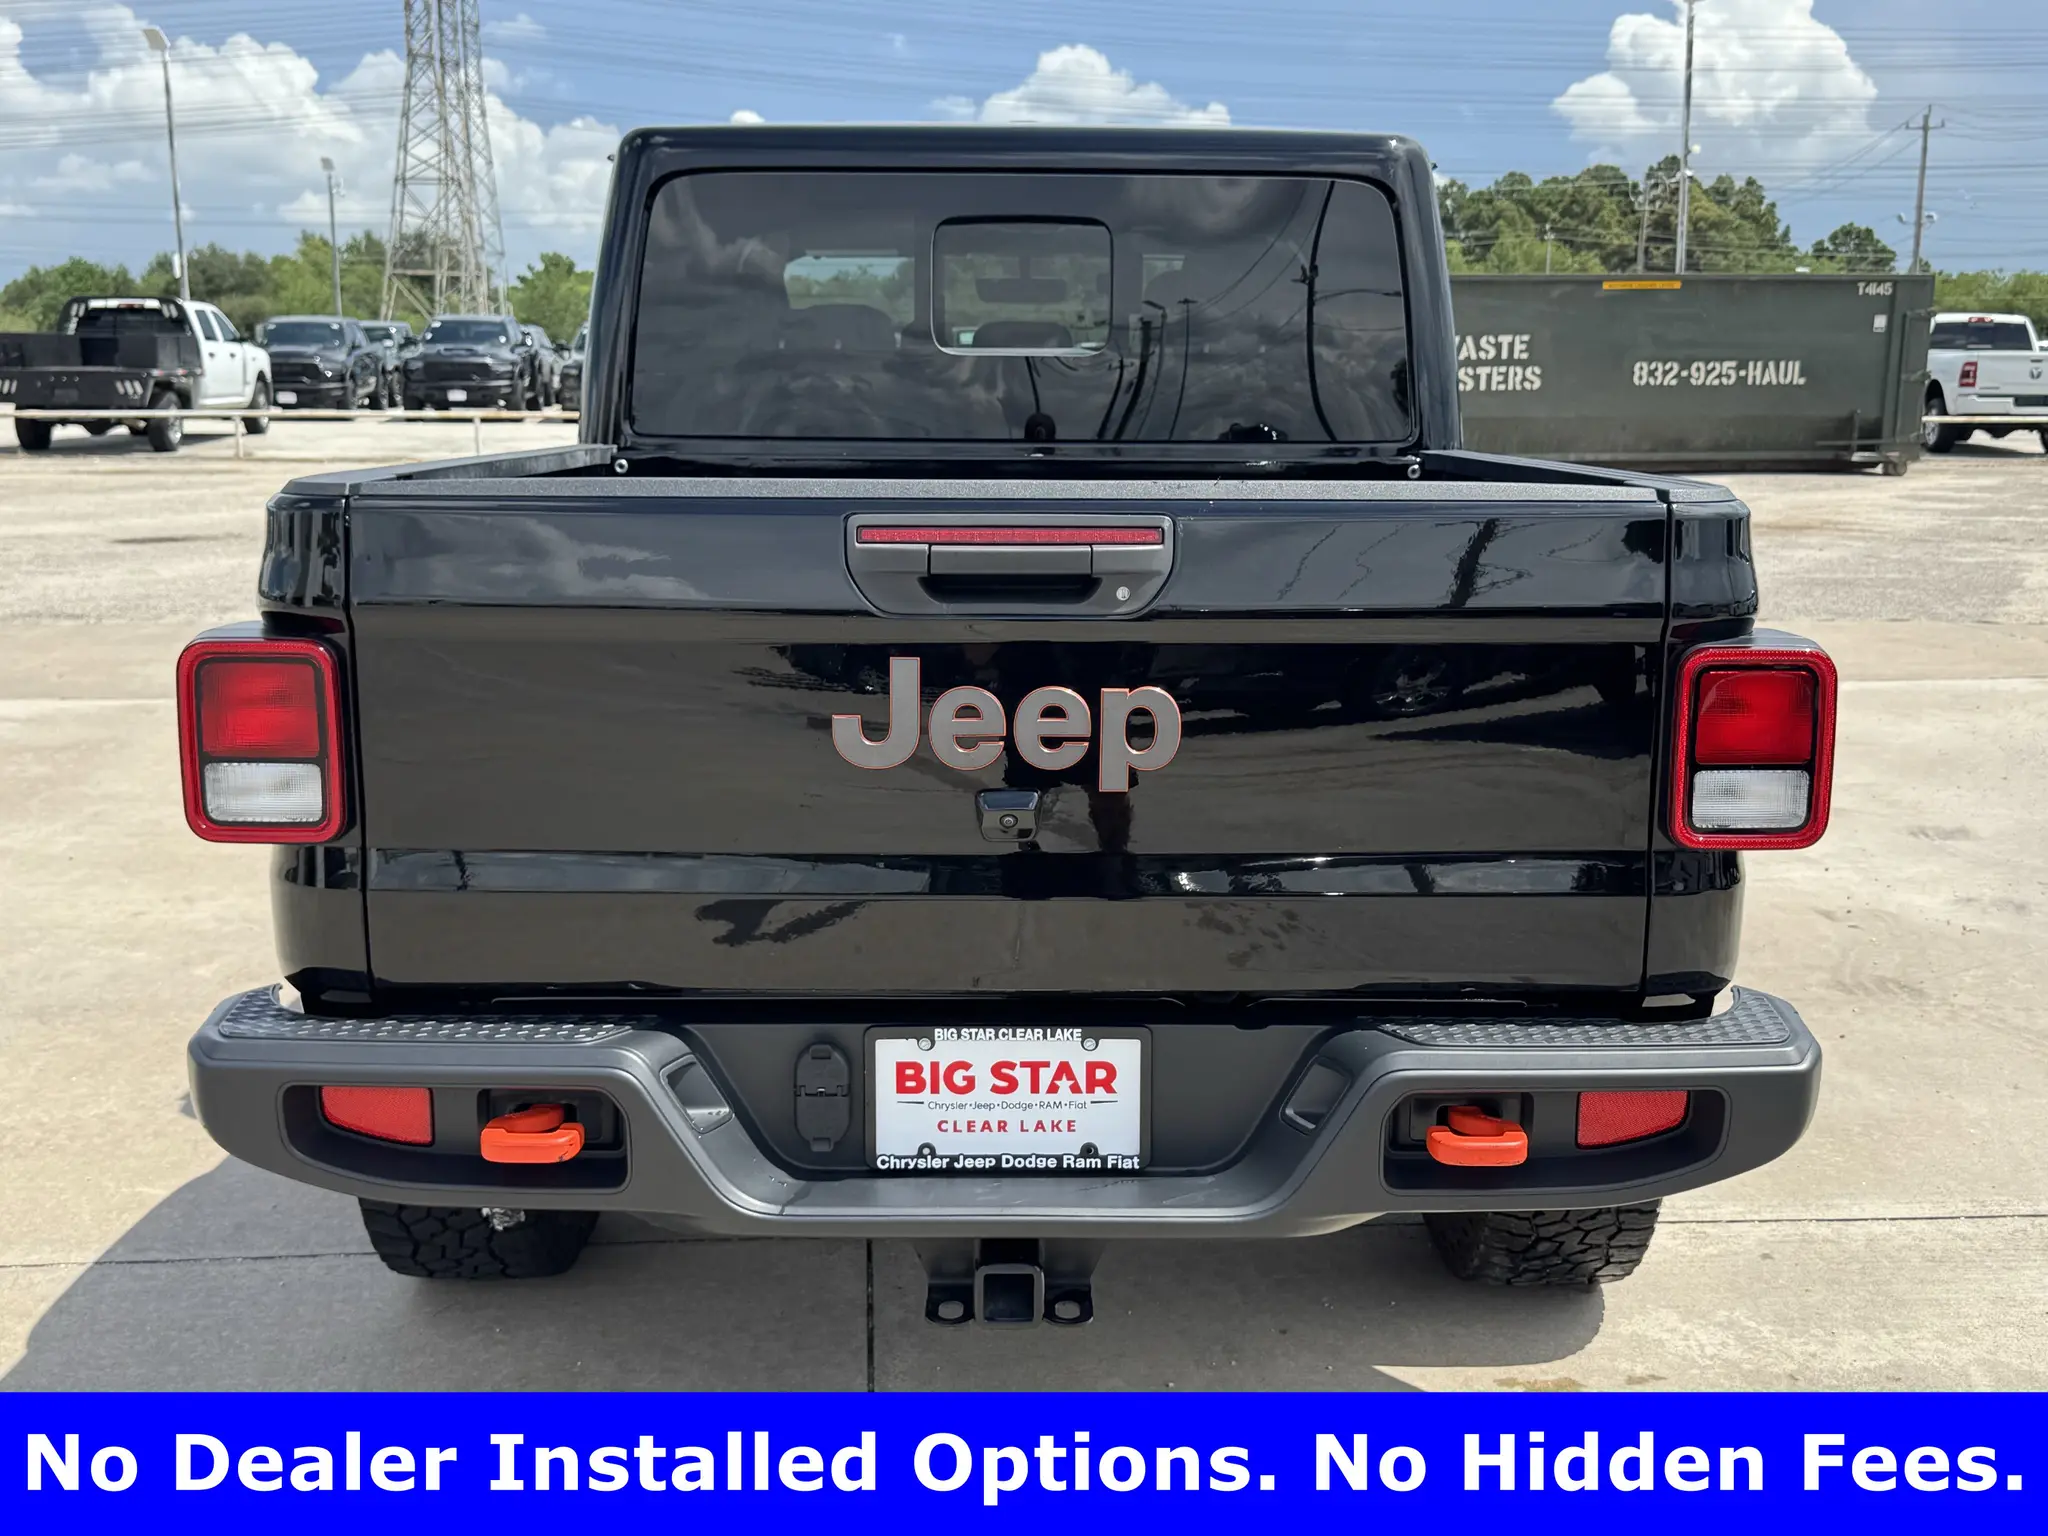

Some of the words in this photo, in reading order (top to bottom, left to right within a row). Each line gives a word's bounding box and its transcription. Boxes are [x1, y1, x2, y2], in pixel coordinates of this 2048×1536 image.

[1455, 334, 1531, 361] ASTE
[1633, 360, 1807, 386] 832-925-HAUL
[832, 656, 1182, 792] Jeep
[934, 1028, 957, 1041] BIG
[961, 1028, 995, 1041] STAR
[998, 1028, 1043, 1041] CLEAR
[1046, 1028, 1082, 1041] LAKE
[895, 1060, 976, 1095] BIG
[990, 1060, 1118, 1095] STAR
[937, 1120, 1009, 1133] CLEAR
[1020, 1120, 1077, 1133] LAKE
[876, 1154, 950, 1170] Chrysler
[954, 1154, 996, 1170] Jeep
[1001, 1154, 1057, 1170] Dodge
[1063, 1155, 1102, 1169] Ram
[1107, 1155, 1140, 1169] Fiat
